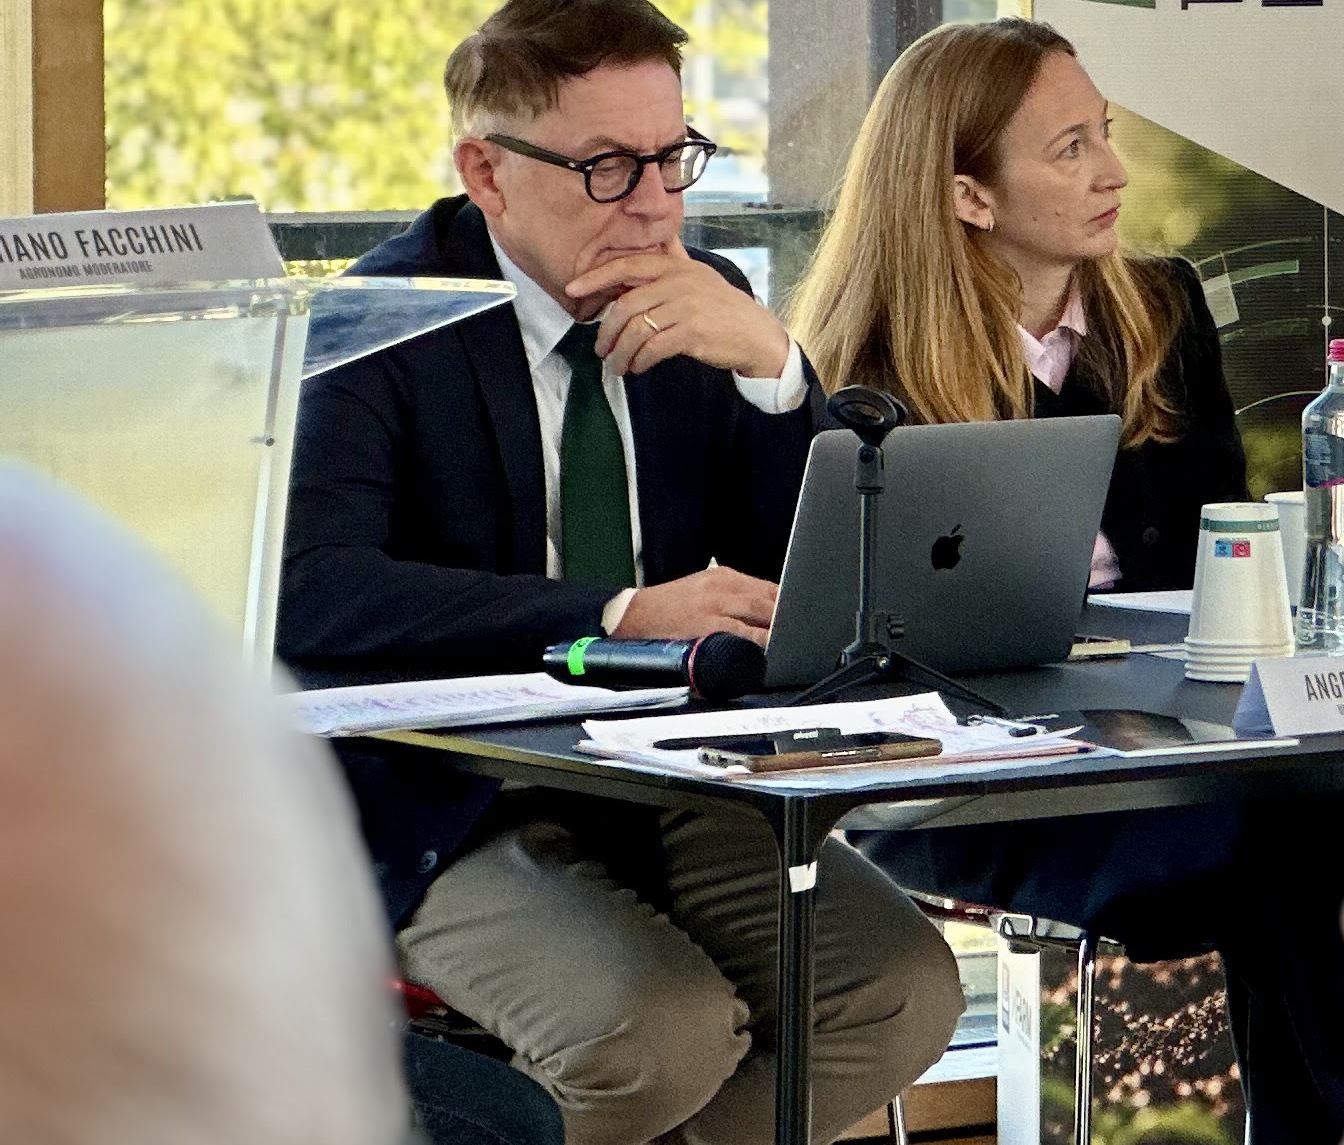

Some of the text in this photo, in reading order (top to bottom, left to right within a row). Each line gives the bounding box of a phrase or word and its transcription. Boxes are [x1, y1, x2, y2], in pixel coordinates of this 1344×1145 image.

[0, 223, 204, 263] IANO FACCHINI
[19, 261, 153, 279] AGRONOMO MODERATORE
